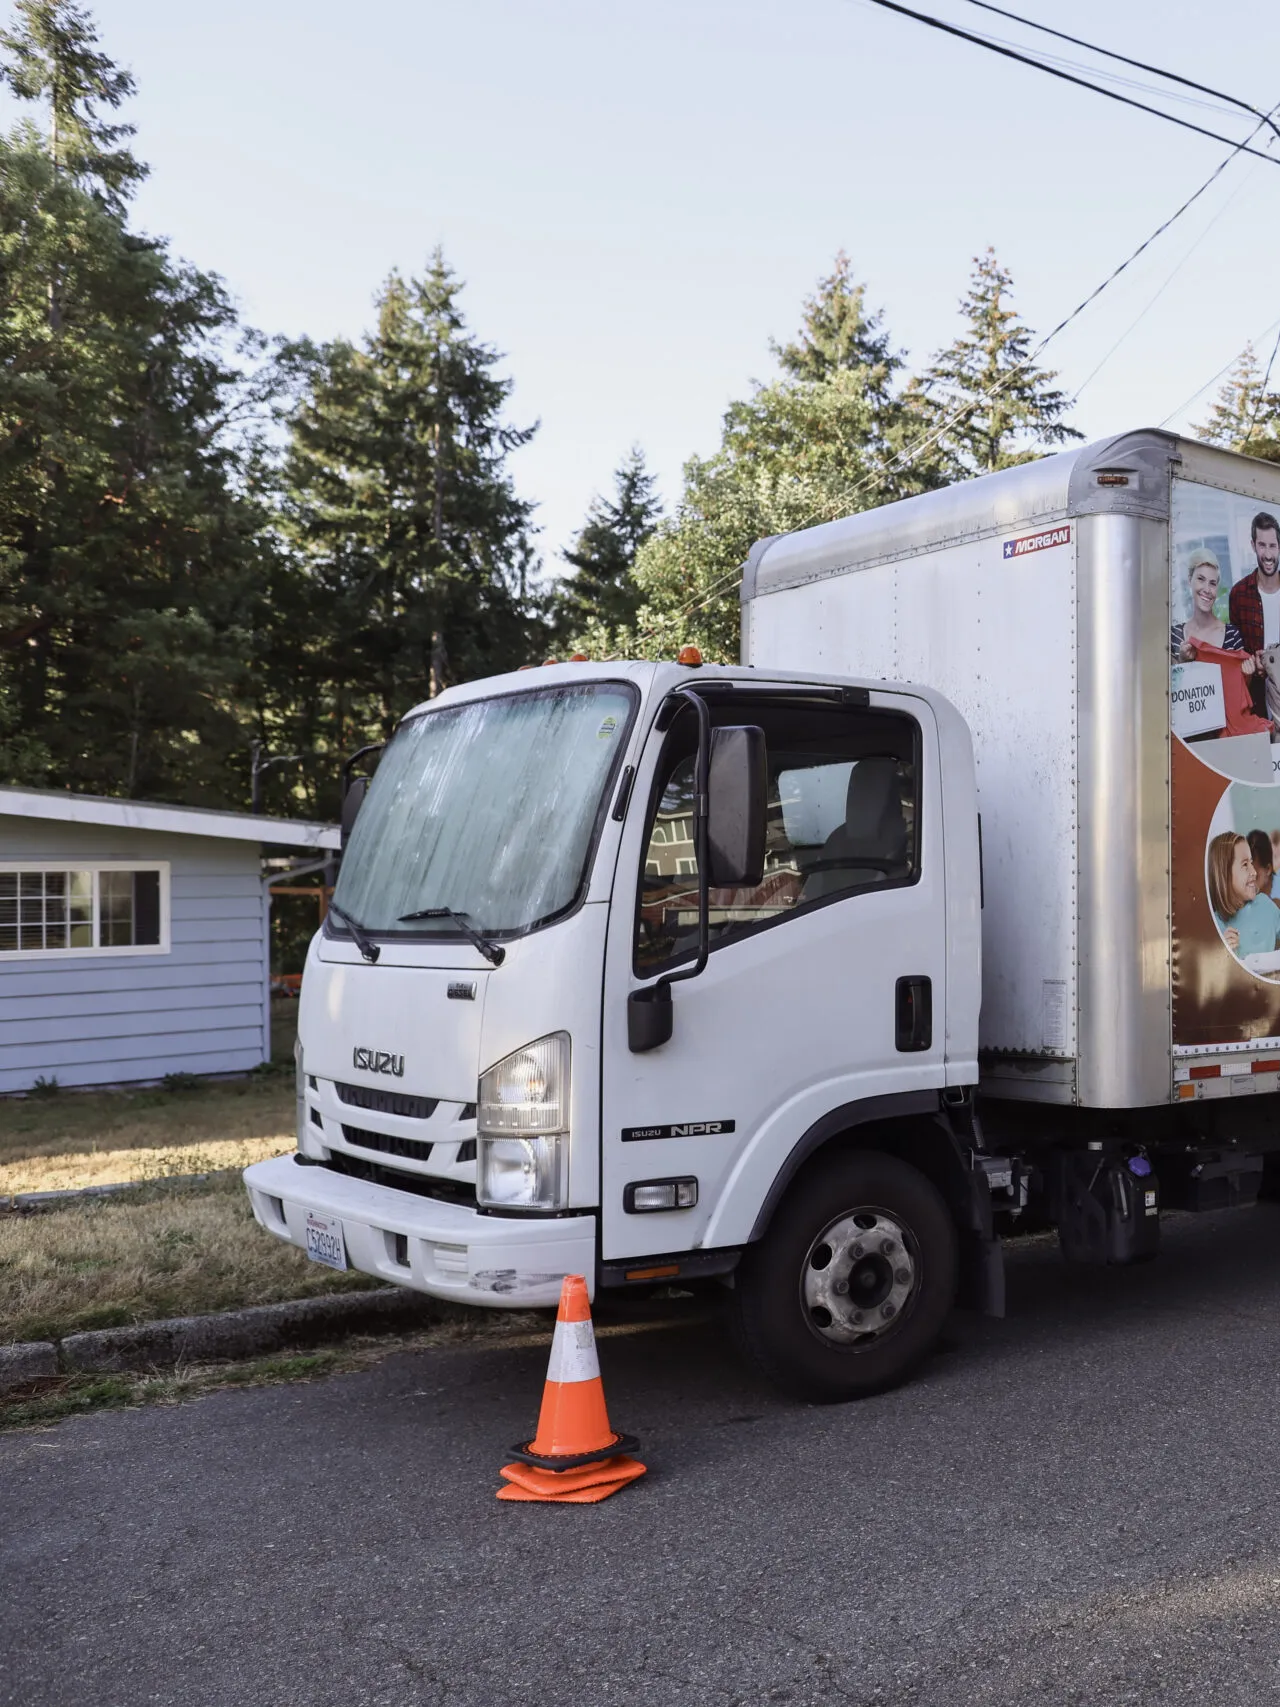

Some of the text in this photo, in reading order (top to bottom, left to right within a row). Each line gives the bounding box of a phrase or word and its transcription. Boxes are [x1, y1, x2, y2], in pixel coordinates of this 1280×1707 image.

[1015, 528, 1069, 554] MORGAN
[1171, 684, 1215, 703] DONATION
[1188, 699, 1207, 713] BOX
[353, 1047, 404, 1078] ISUZU
[632, 1122, 722, 1138] ISUZU NPR
